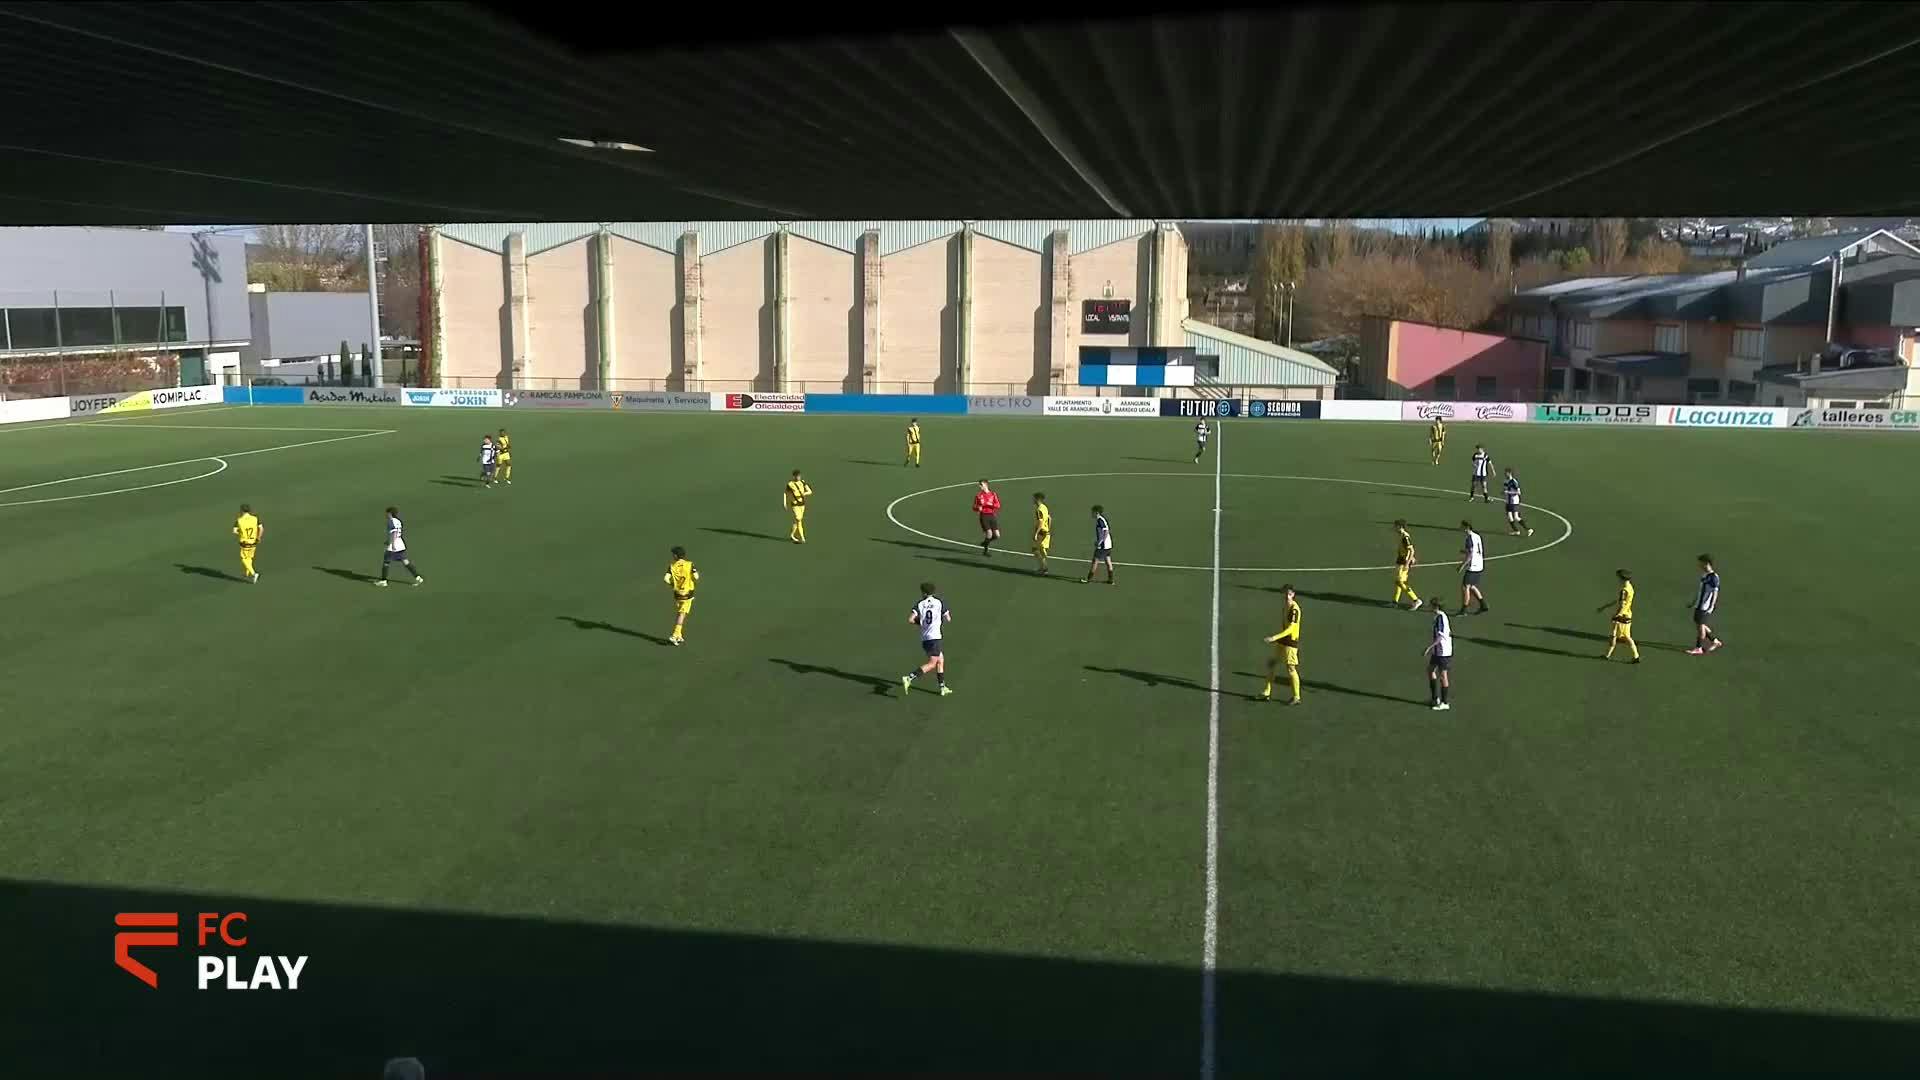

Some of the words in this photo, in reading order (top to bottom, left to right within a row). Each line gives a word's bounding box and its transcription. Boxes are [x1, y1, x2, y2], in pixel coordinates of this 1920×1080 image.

[153, 390, 201, 404] KOMIPLAC
[72, 398, 116, 412] JOYFER
[1180, 400, 1216, 416] FUTUR
[1267, 402, 1301, 412] SEGUNDA
[1542, 405, 1650, 416] TOLDOS
[1675, 410, 1774, 425] Lacunza
[1822, 411, 1884, 423] talleres
[1890, 411, 1918, 423] CR
[245, 528, 255, 539] 12
[926, 610, 932, 625] 9
